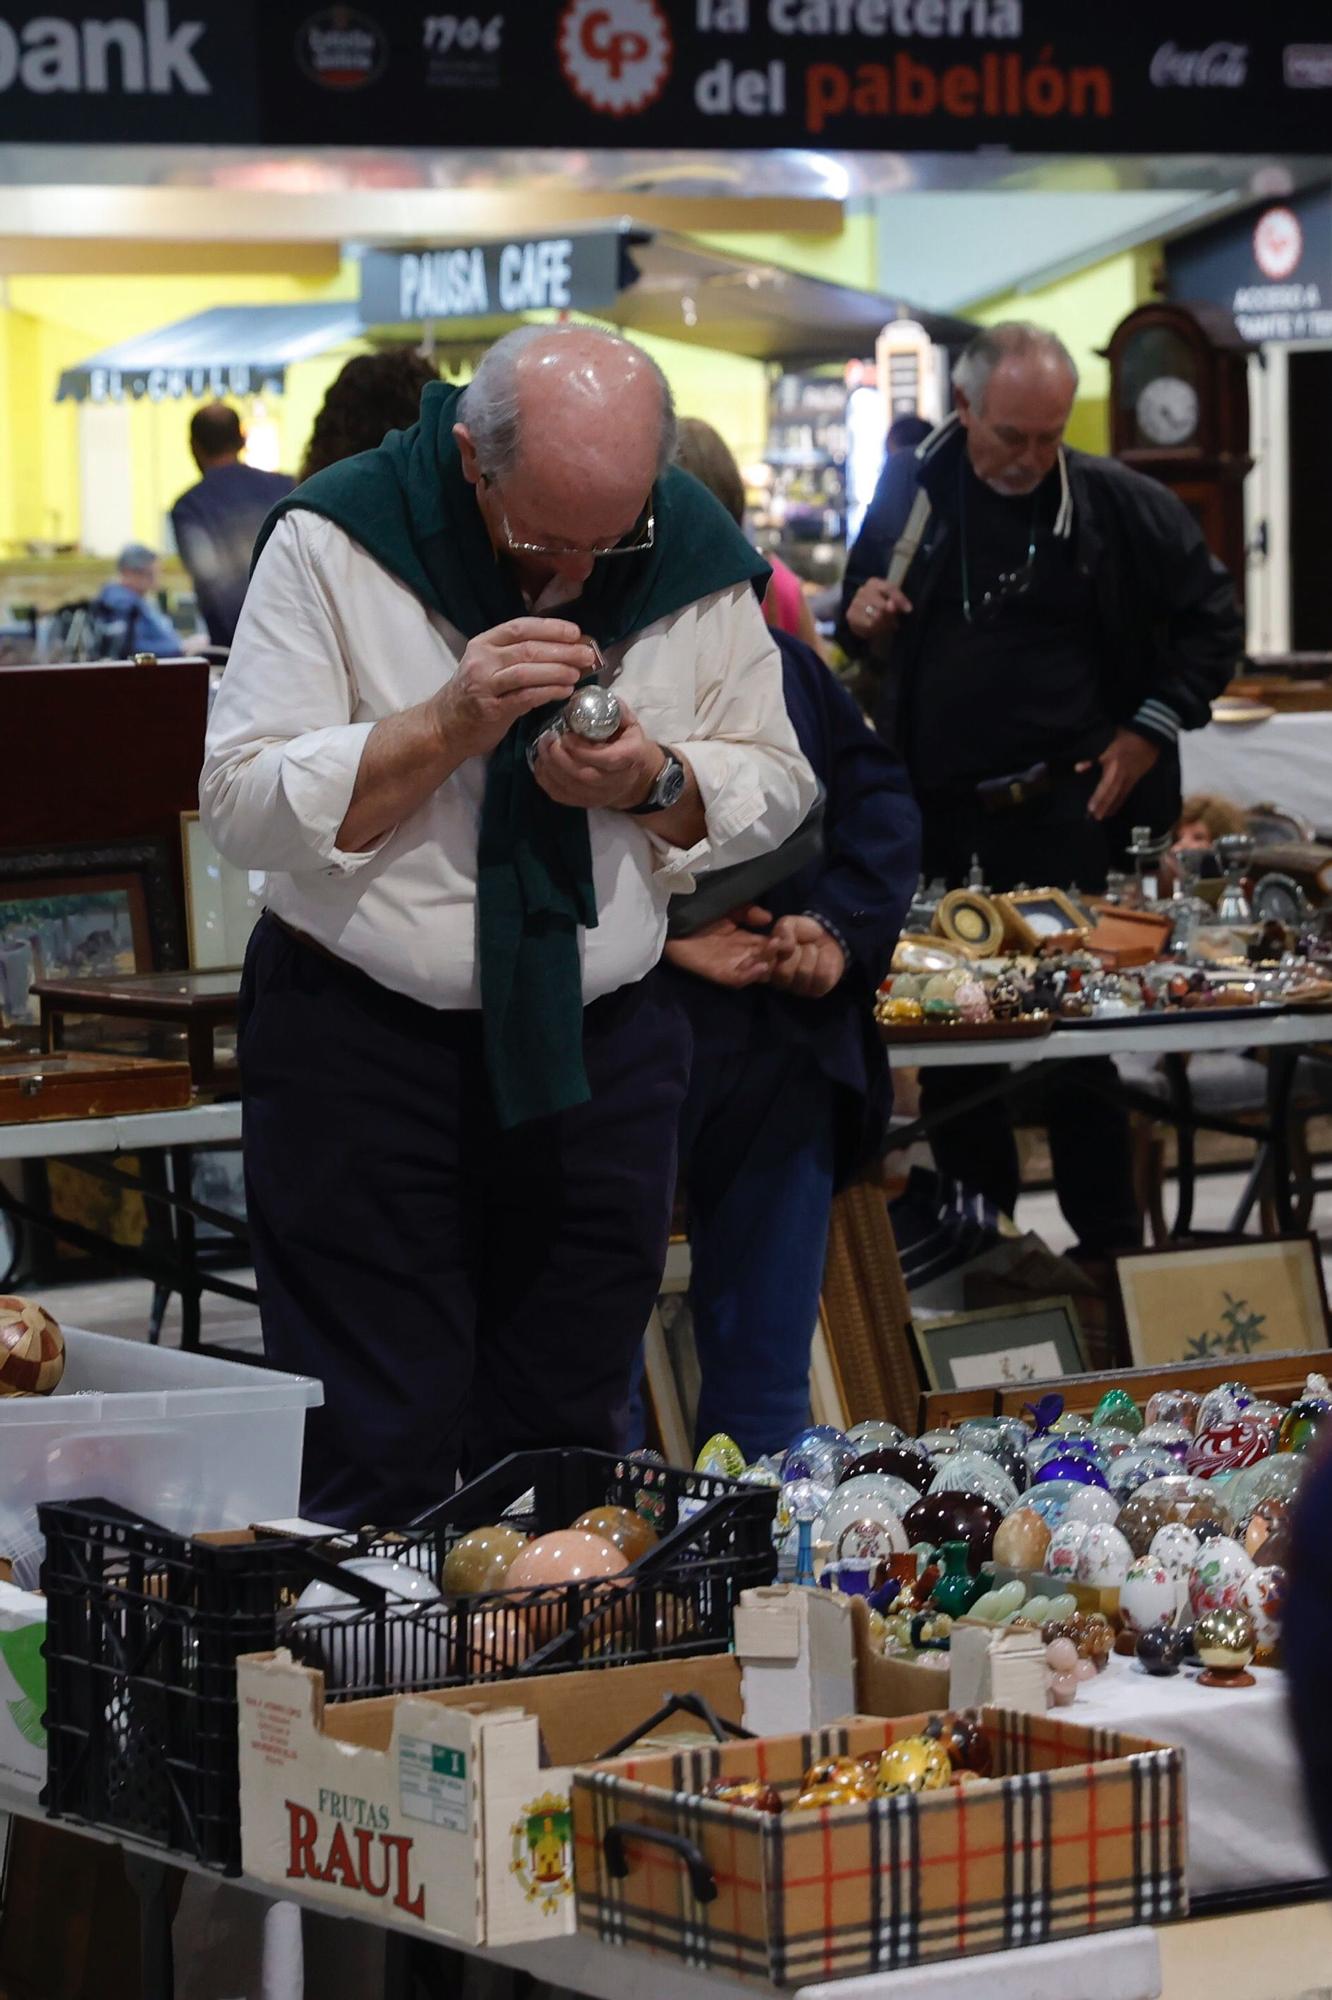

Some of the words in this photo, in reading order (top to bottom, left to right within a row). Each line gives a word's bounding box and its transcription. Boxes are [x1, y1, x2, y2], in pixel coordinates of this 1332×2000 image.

[0, 0, 211, 94] ank
[694, 58, 785, 115] del
[805, 44, 1112, 134] pabellón
[400, 248, 489, 319] PAUSA
[318, 1788, 390, 1831] FRUTAS
[285, 1799, 426, 1921] RAUL
